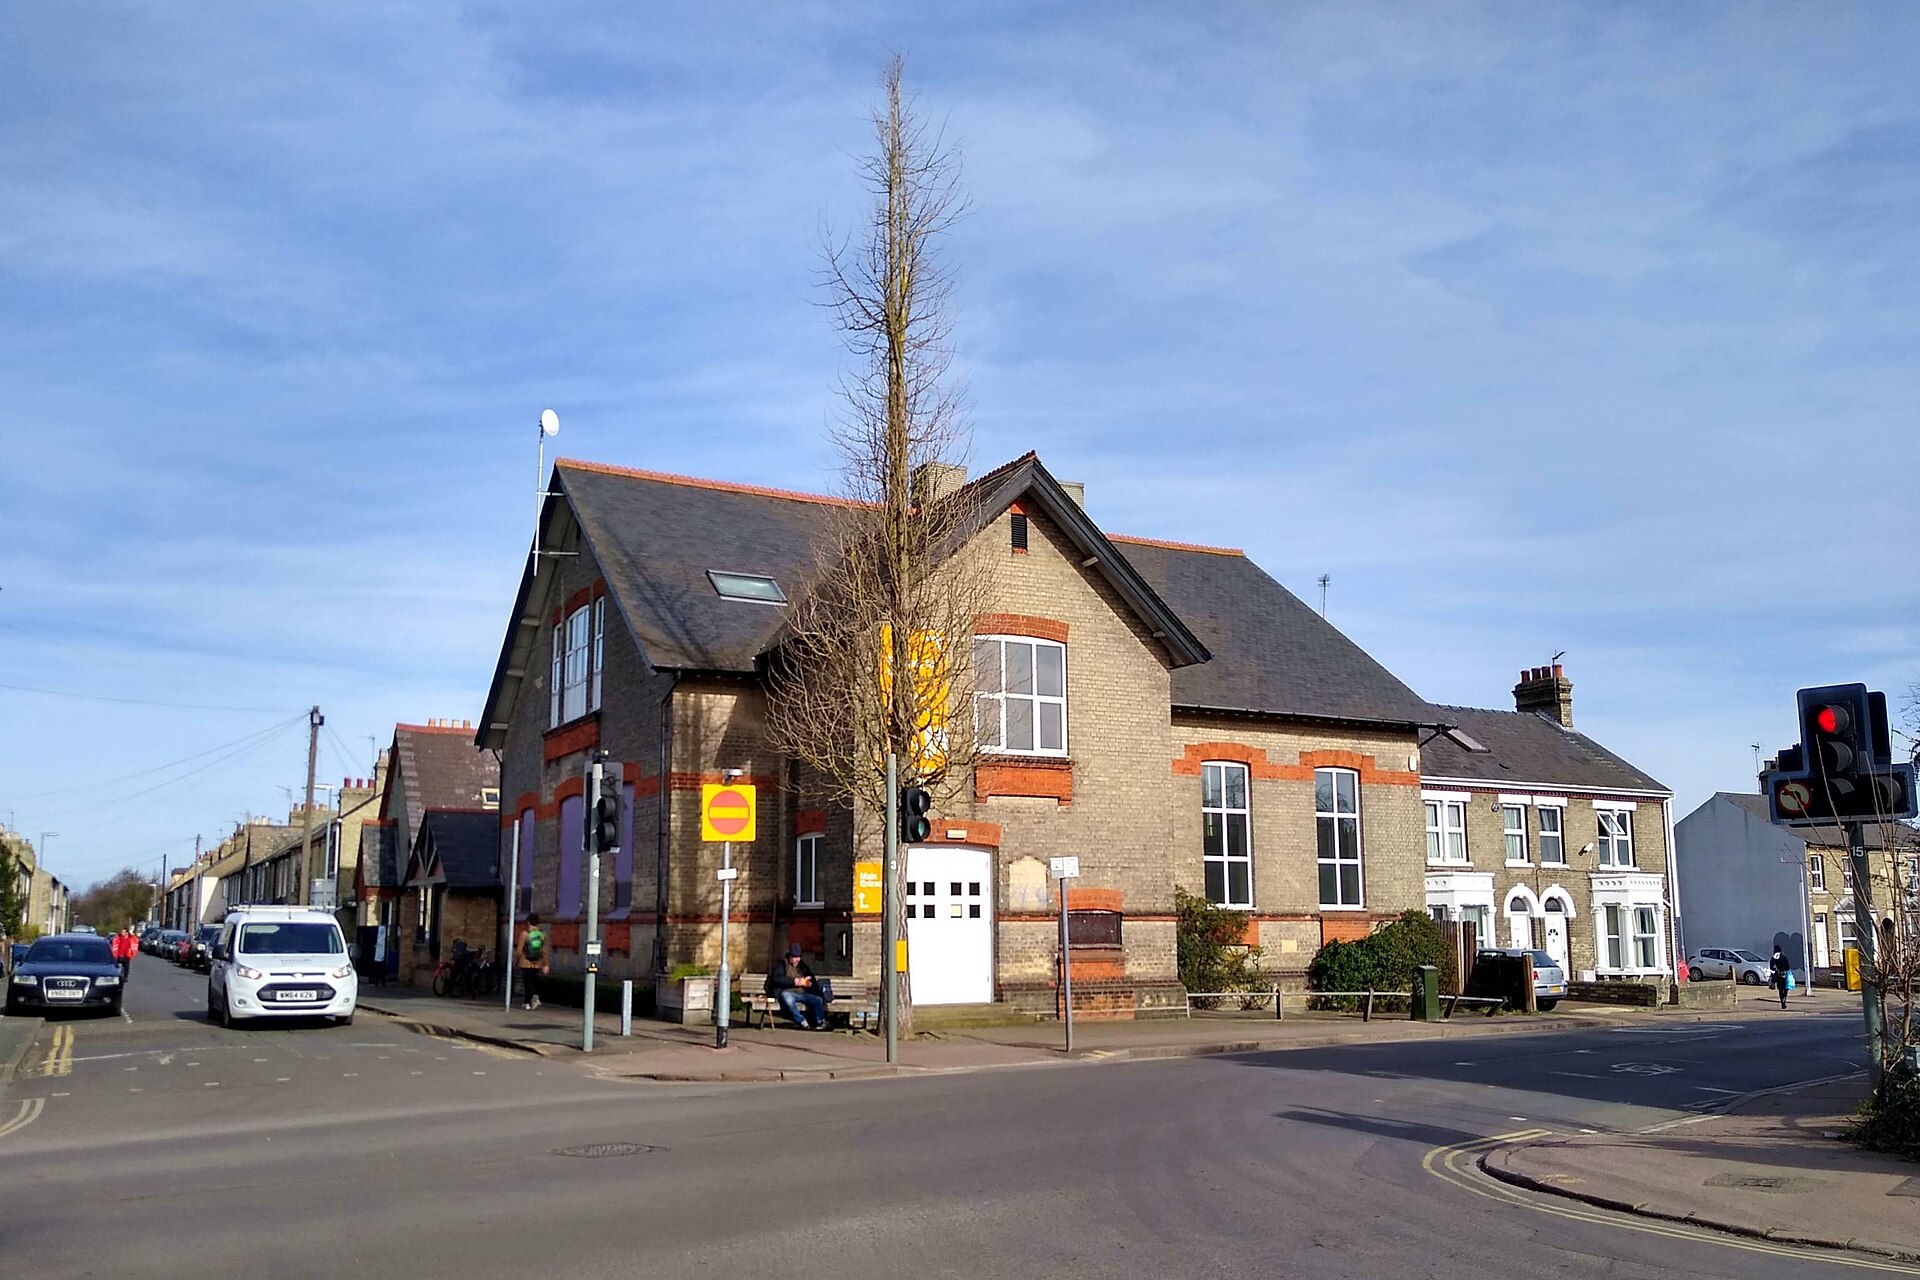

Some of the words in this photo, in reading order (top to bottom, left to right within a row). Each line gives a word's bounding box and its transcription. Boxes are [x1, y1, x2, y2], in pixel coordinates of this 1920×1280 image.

[1850, 845, 1864, 857] 15
[890, 860, 897, 870] 3
[859, 871, 878, 880] Main
